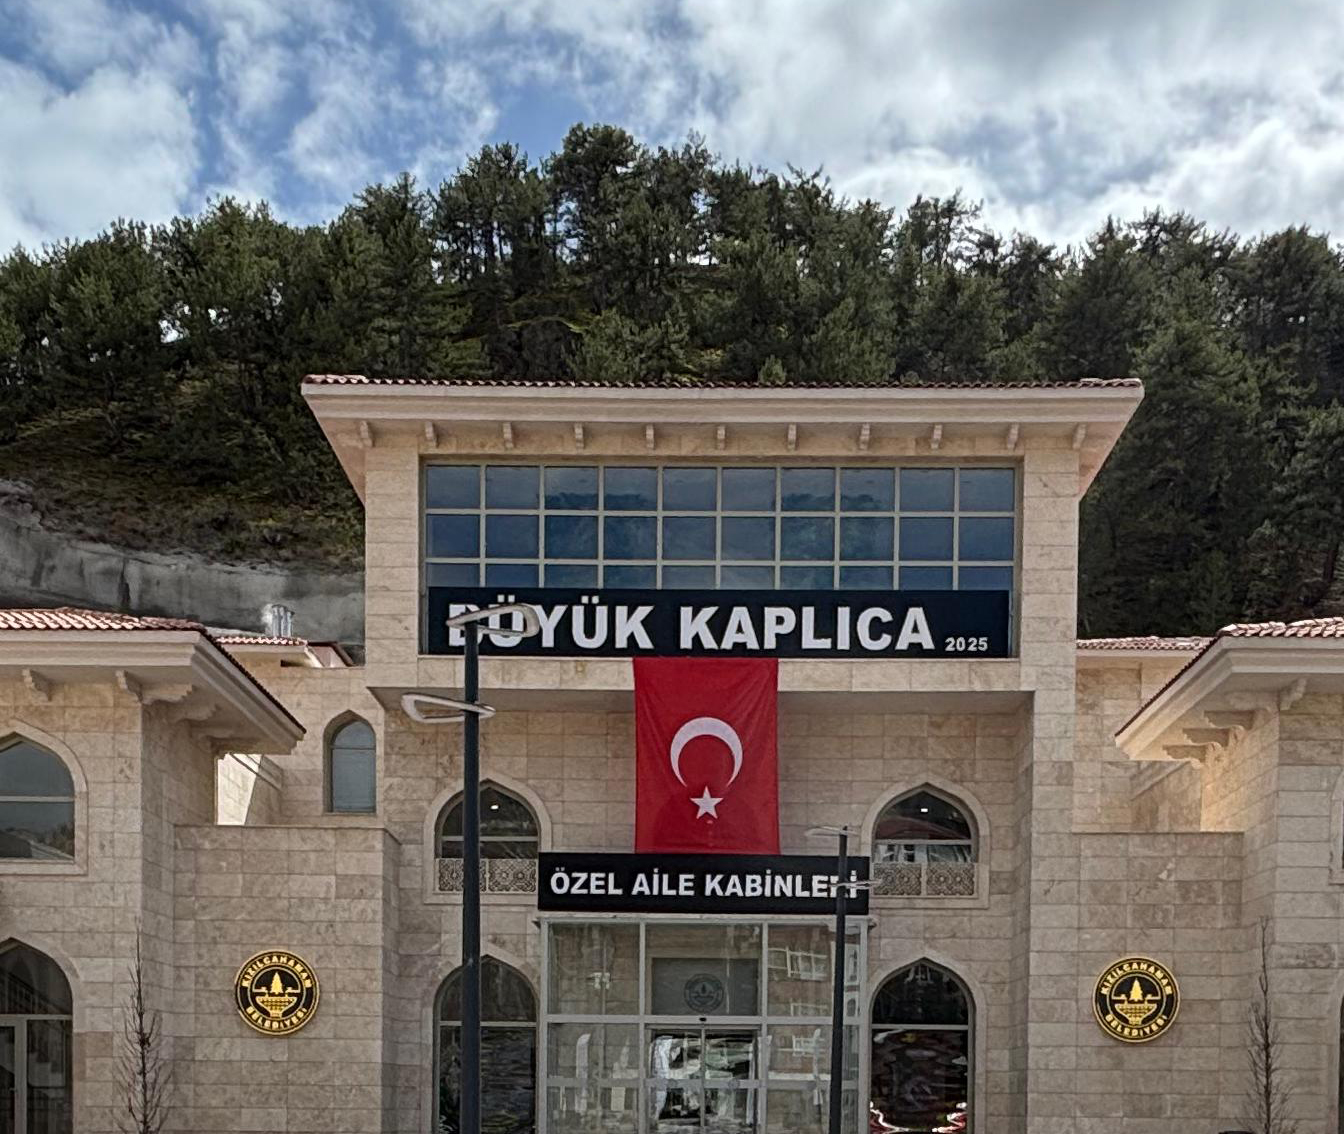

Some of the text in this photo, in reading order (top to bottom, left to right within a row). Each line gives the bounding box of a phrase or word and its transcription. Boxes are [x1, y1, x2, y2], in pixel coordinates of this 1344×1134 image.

[680, 605, 936, 651] KAPLICA
[945, 636, 989, 652] 2025
[550, 867, 623, 895] ÖZEL
[631, 868, 696, 896] AİLE
